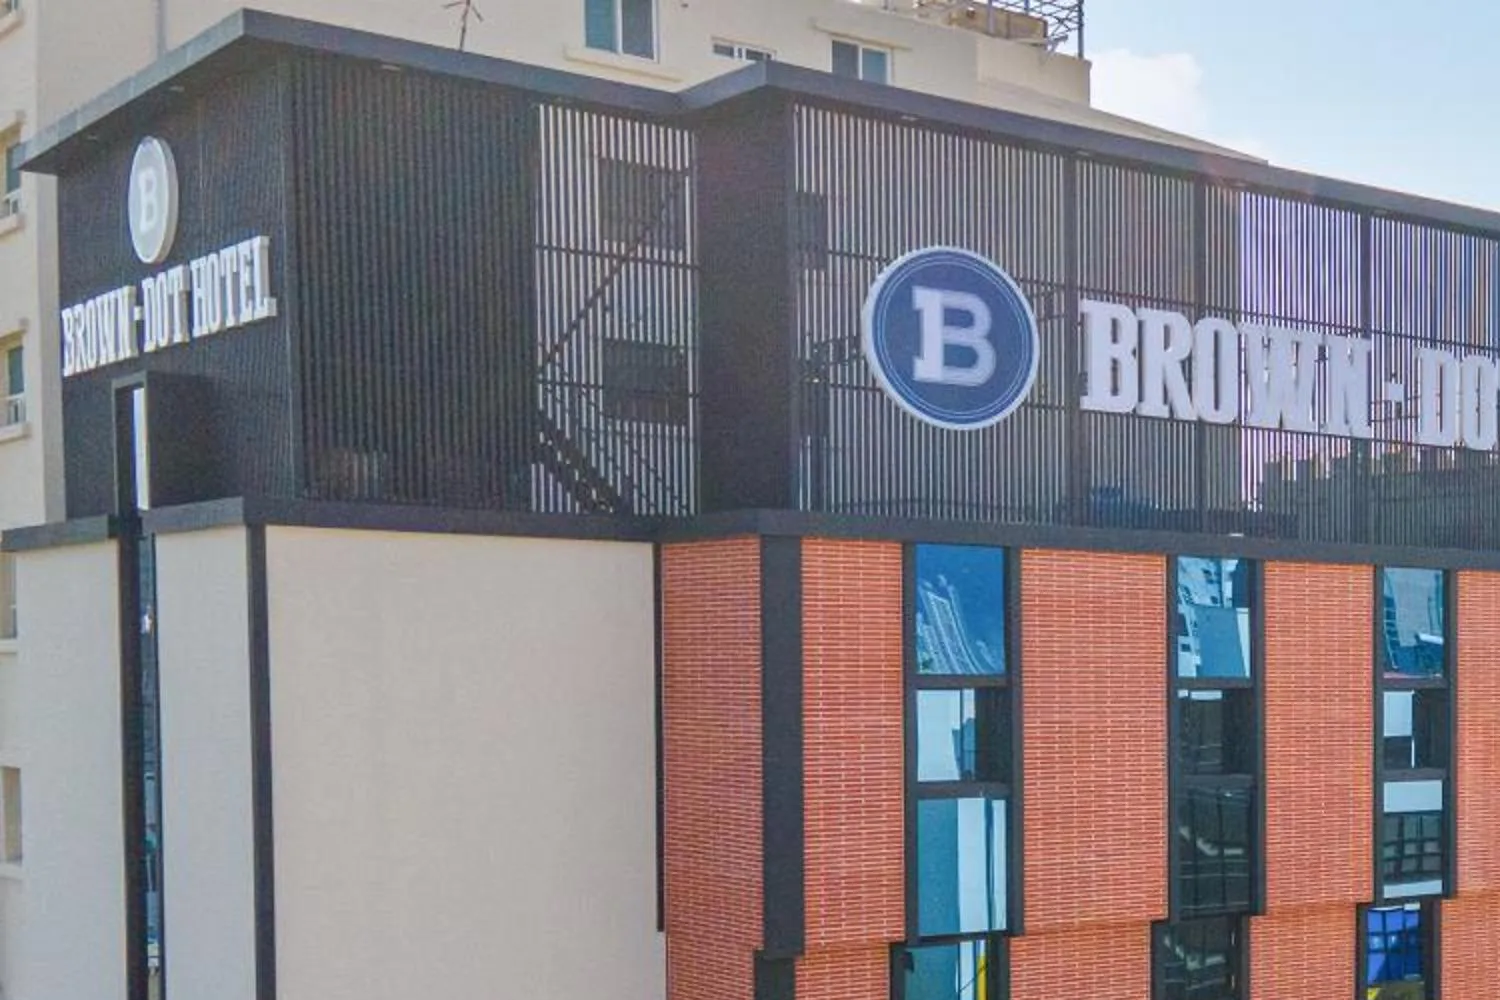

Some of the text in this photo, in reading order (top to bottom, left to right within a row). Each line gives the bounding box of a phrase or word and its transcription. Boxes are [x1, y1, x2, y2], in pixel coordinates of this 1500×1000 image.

[138, 169, 157, 232] B
[190, 235, 277, 337] HOTEL
[912, 285, 997, 387] B
